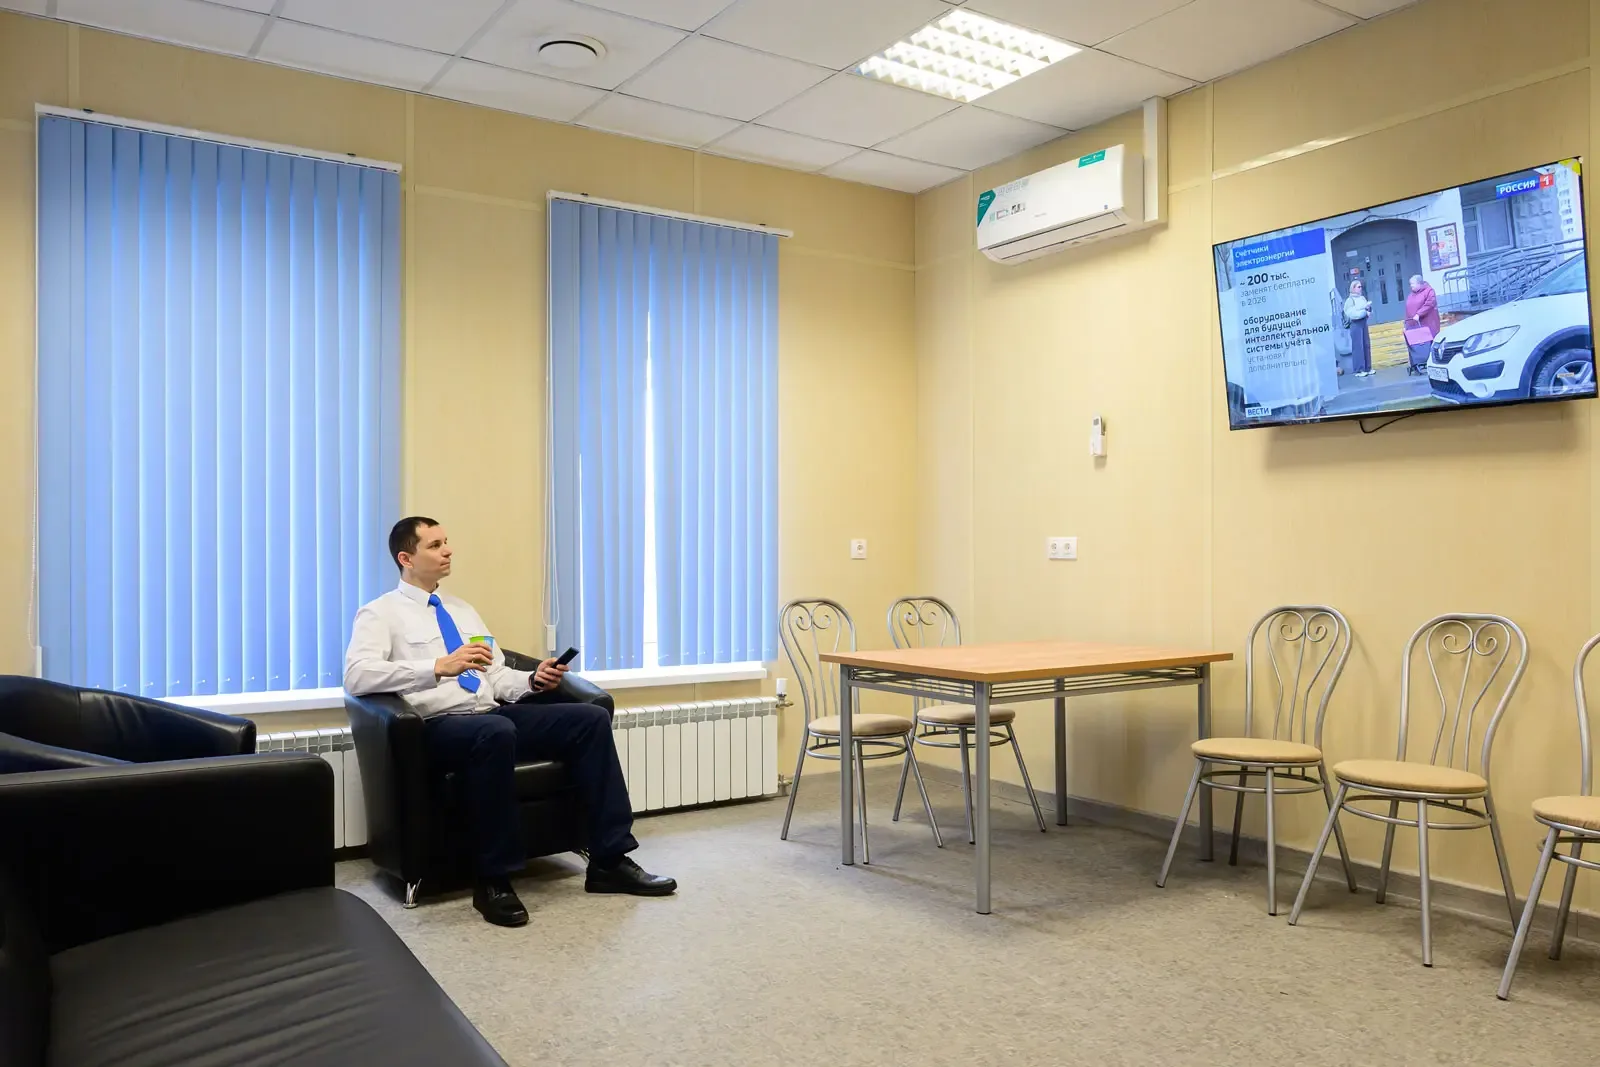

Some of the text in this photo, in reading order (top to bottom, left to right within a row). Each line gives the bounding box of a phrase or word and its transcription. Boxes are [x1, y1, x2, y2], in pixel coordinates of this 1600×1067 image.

[1500, 175, 1550, 194] РОССИЯ 1
[1235, 249, 1295, 268] электроэнергии
[1240, 277, 1316, 297] заменят бесплатно
[1247, 272, 1269, 286] 200
[1270, 272, 1290, 281] тыс.
[1243, 308, 1307, 325] оборудование
[1244, 318, 1302, 336] для будущей
[1245, 323, 1330, 345] интеллектуальной
[1246, 337, 1312, 354] системы учёта
[1248, 359, 1308, 373] дополнительно
[1247, 407, 1270, 416] ВЕСТИ
